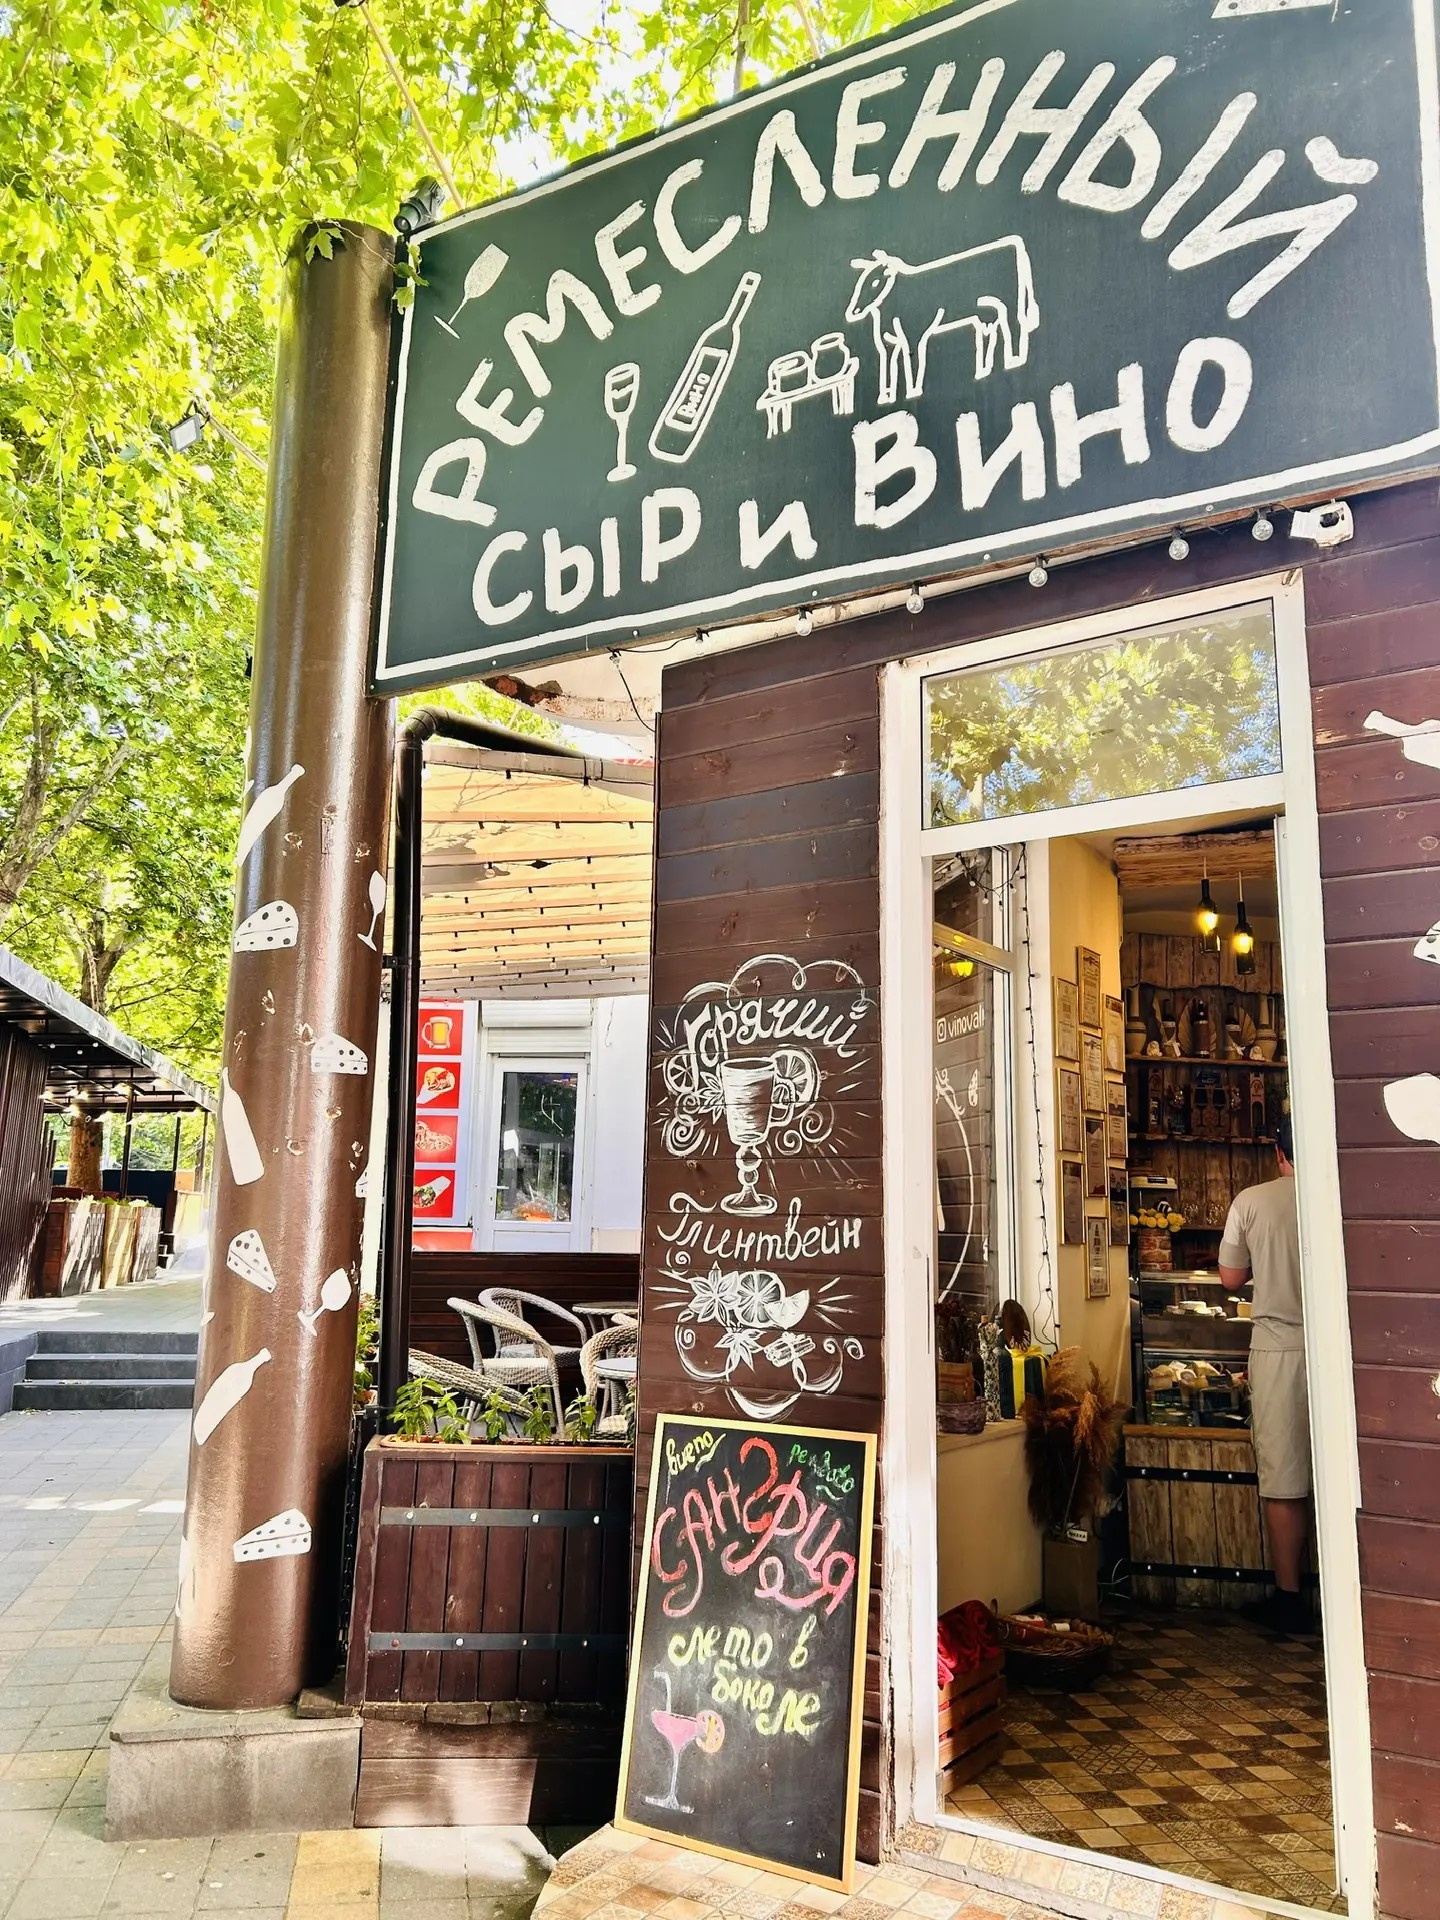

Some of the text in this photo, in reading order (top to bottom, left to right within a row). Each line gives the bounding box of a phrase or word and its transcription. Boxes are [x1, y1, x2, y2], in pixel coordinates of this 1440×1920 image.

[412, 49, 1380, 528] РЕМЕСЛЕННЫЙ
[472, 487, 702, 627] СЫР
[851, 336, 1254, 530] ВИНО
[656, 1191, 862, 1263] Глинтвейн
